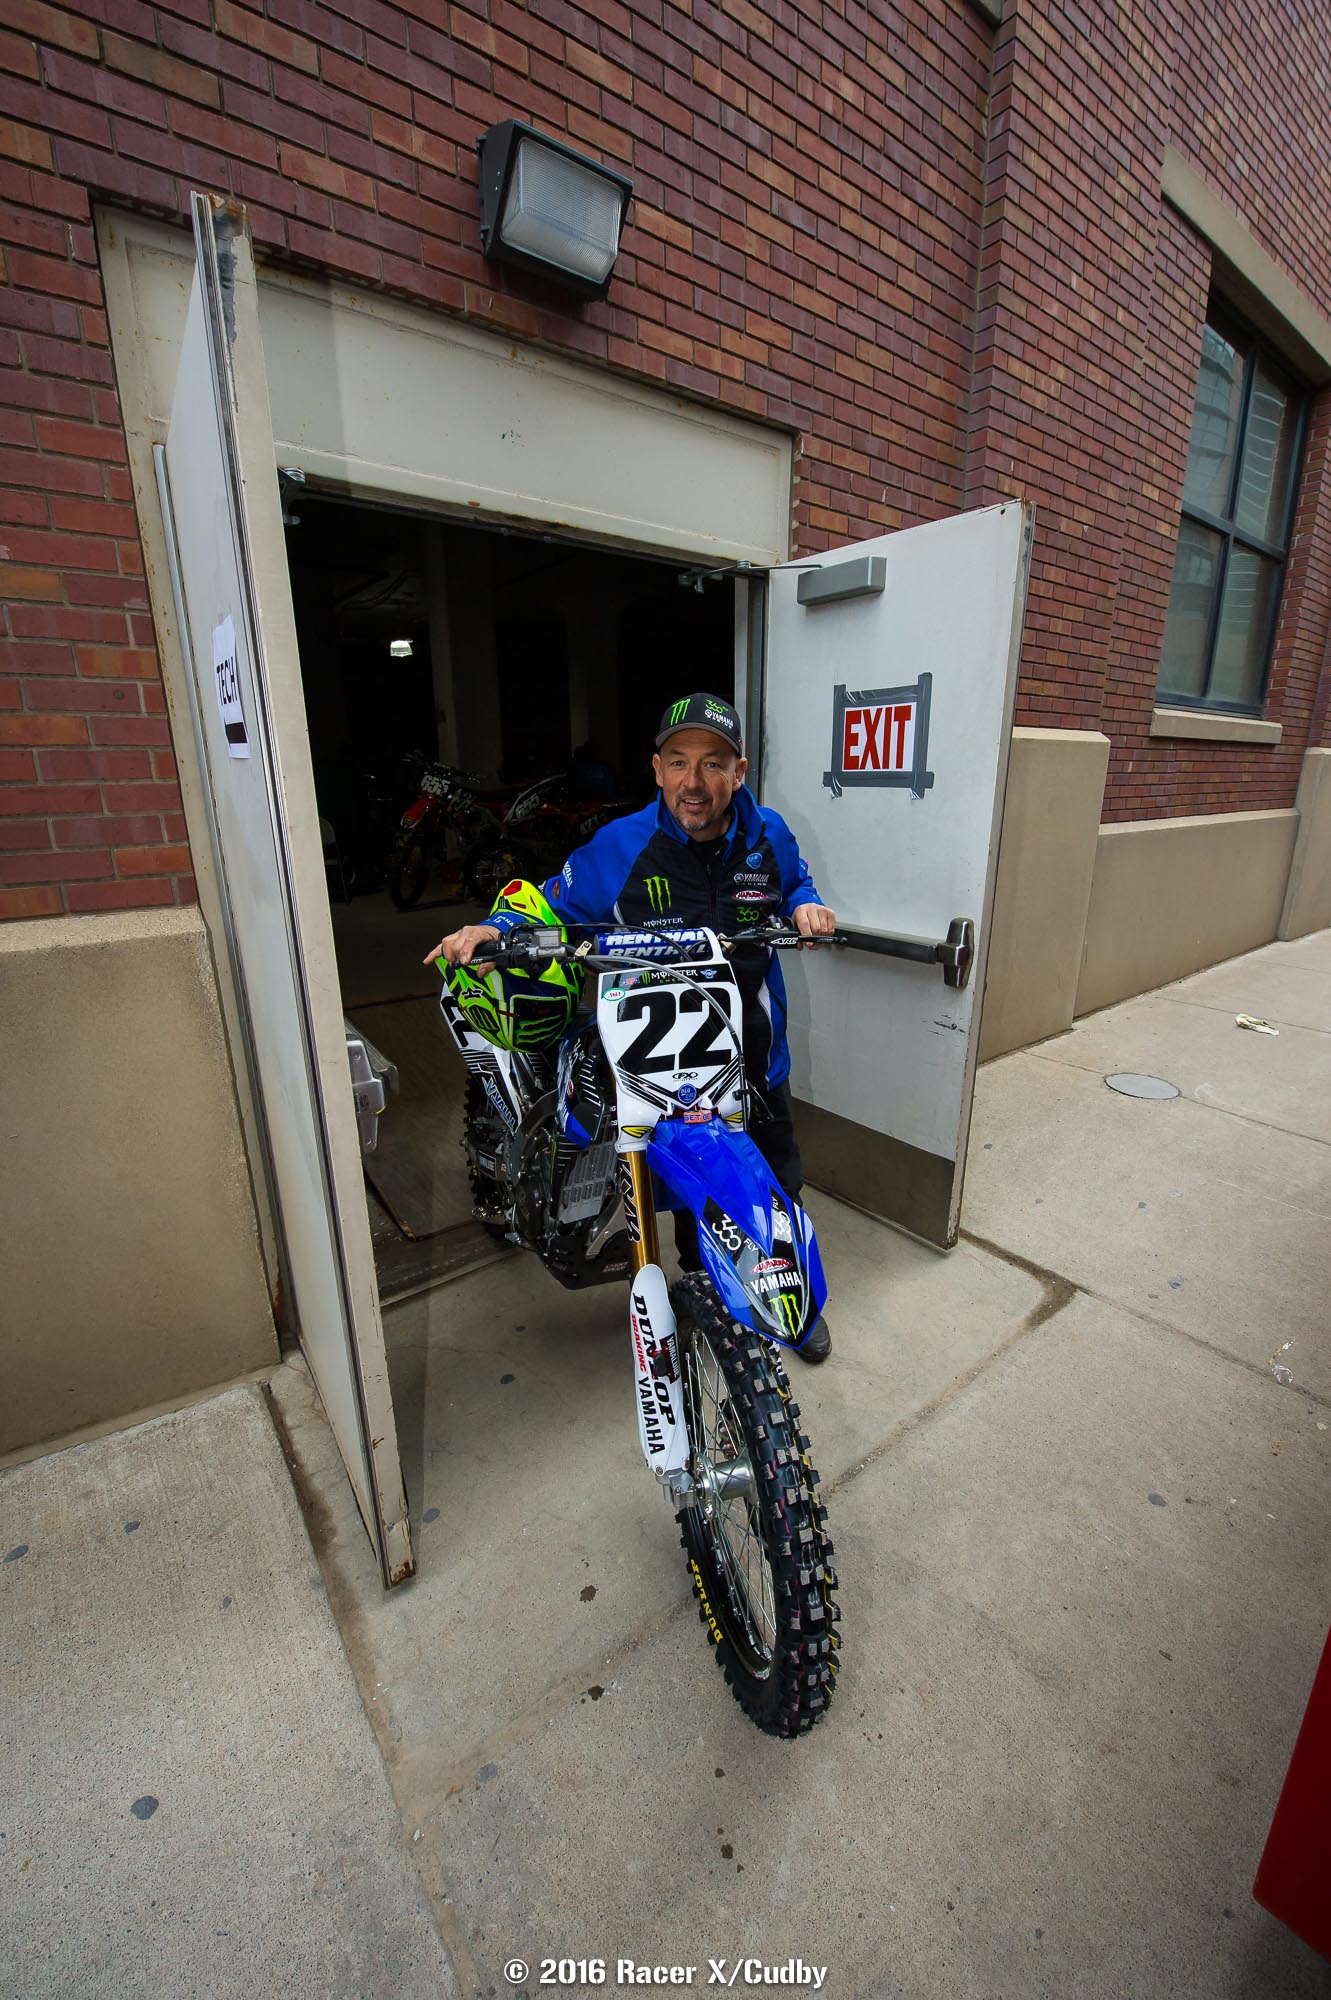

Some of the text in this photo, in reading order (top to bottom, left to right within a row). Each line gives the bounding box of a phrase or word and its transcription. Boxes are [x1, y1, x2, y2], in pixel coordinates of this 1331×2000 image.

[216, 656, 238, 705] TECH
[712, 711, 734, 729] YAMAHA
[843, 705, 912, 770] EXIT
[743, 873, 770, 883] YAMAHA
[643, 917, 684, 928] MONSTER
[737, 906, 759, 923] 360
[605, 929, 707, 946] RENTHAL
[608, 943, 708, 958] RENTHL
[617, 987, 732, 1076] 22
[711, 1213, 742, 1251] 360
[743, 1237, 759, 1252] FLY
[750, 1271, 802, 1295] YAMAHA
[631, 1313, 647, 1372] BRAKING
[632, 1292, 676, 1426] DUNOP
[666, 1336, 680, 1378] YAMALUBE
[638, 1376, 666, 1455] YAMAHA
[690, 1559, 724, 1644] DUNLOP
